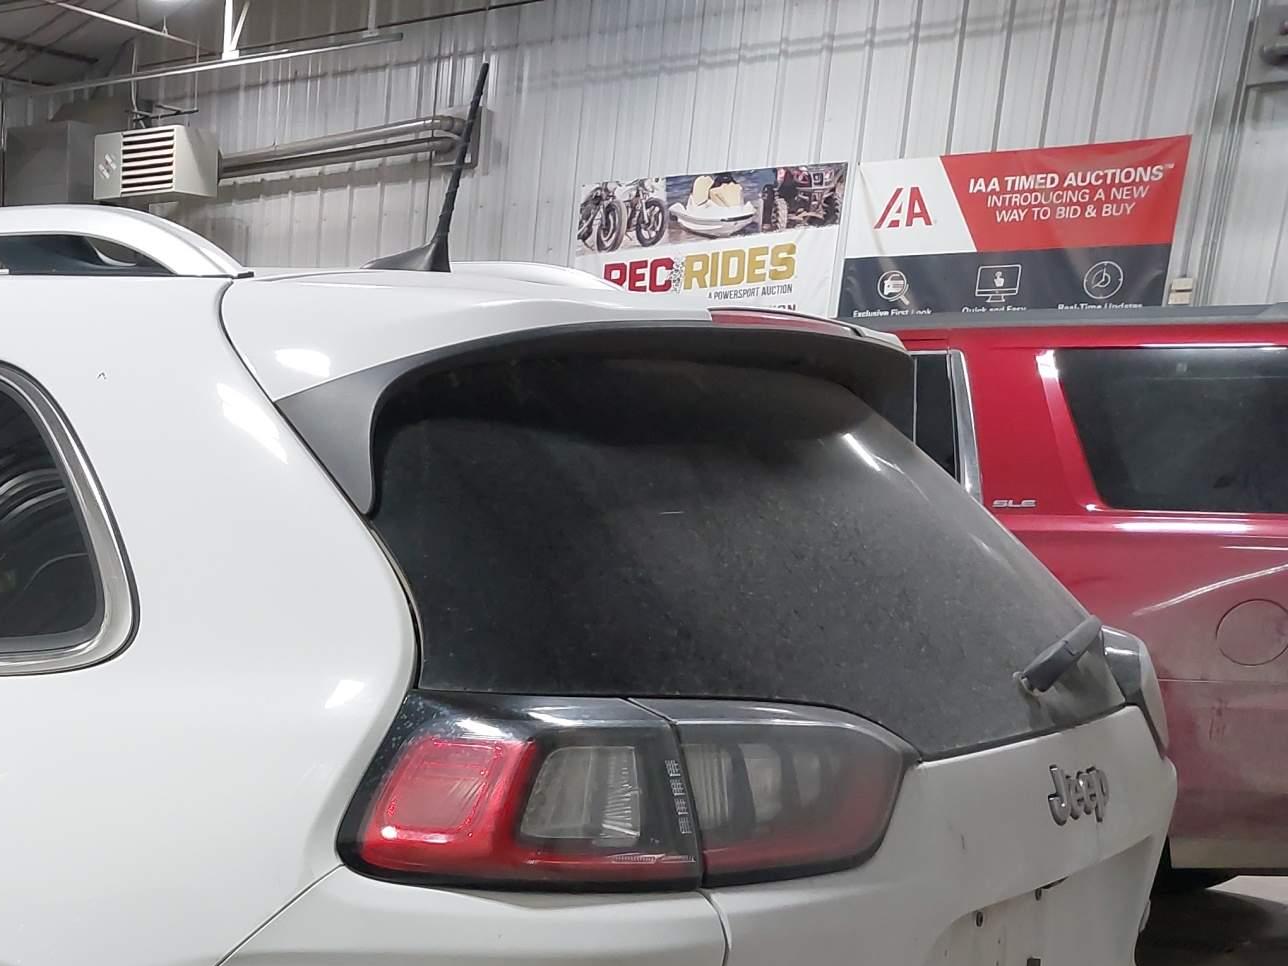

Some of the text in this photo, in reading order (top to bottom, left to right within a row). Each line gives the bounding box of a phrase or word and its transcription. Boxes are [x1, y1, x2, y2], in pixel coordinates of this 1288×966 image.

[969, 176, 1000, 194] IAA
[1004, 173, 1060, 191] TIMED
[987, 186, 1150, 208] INTRODUCING A NEW
[996, 202, 1136, 223] WAY TO BID & BUY
[683, 243, 797, 290] RIDES
[714, 286, 760, 300] POWERSPORT
[761, 284, 793, 297] AUCTION
[992, 499, 1037, 508] SLE
[1048, 764, 1110, 826] Jeep
